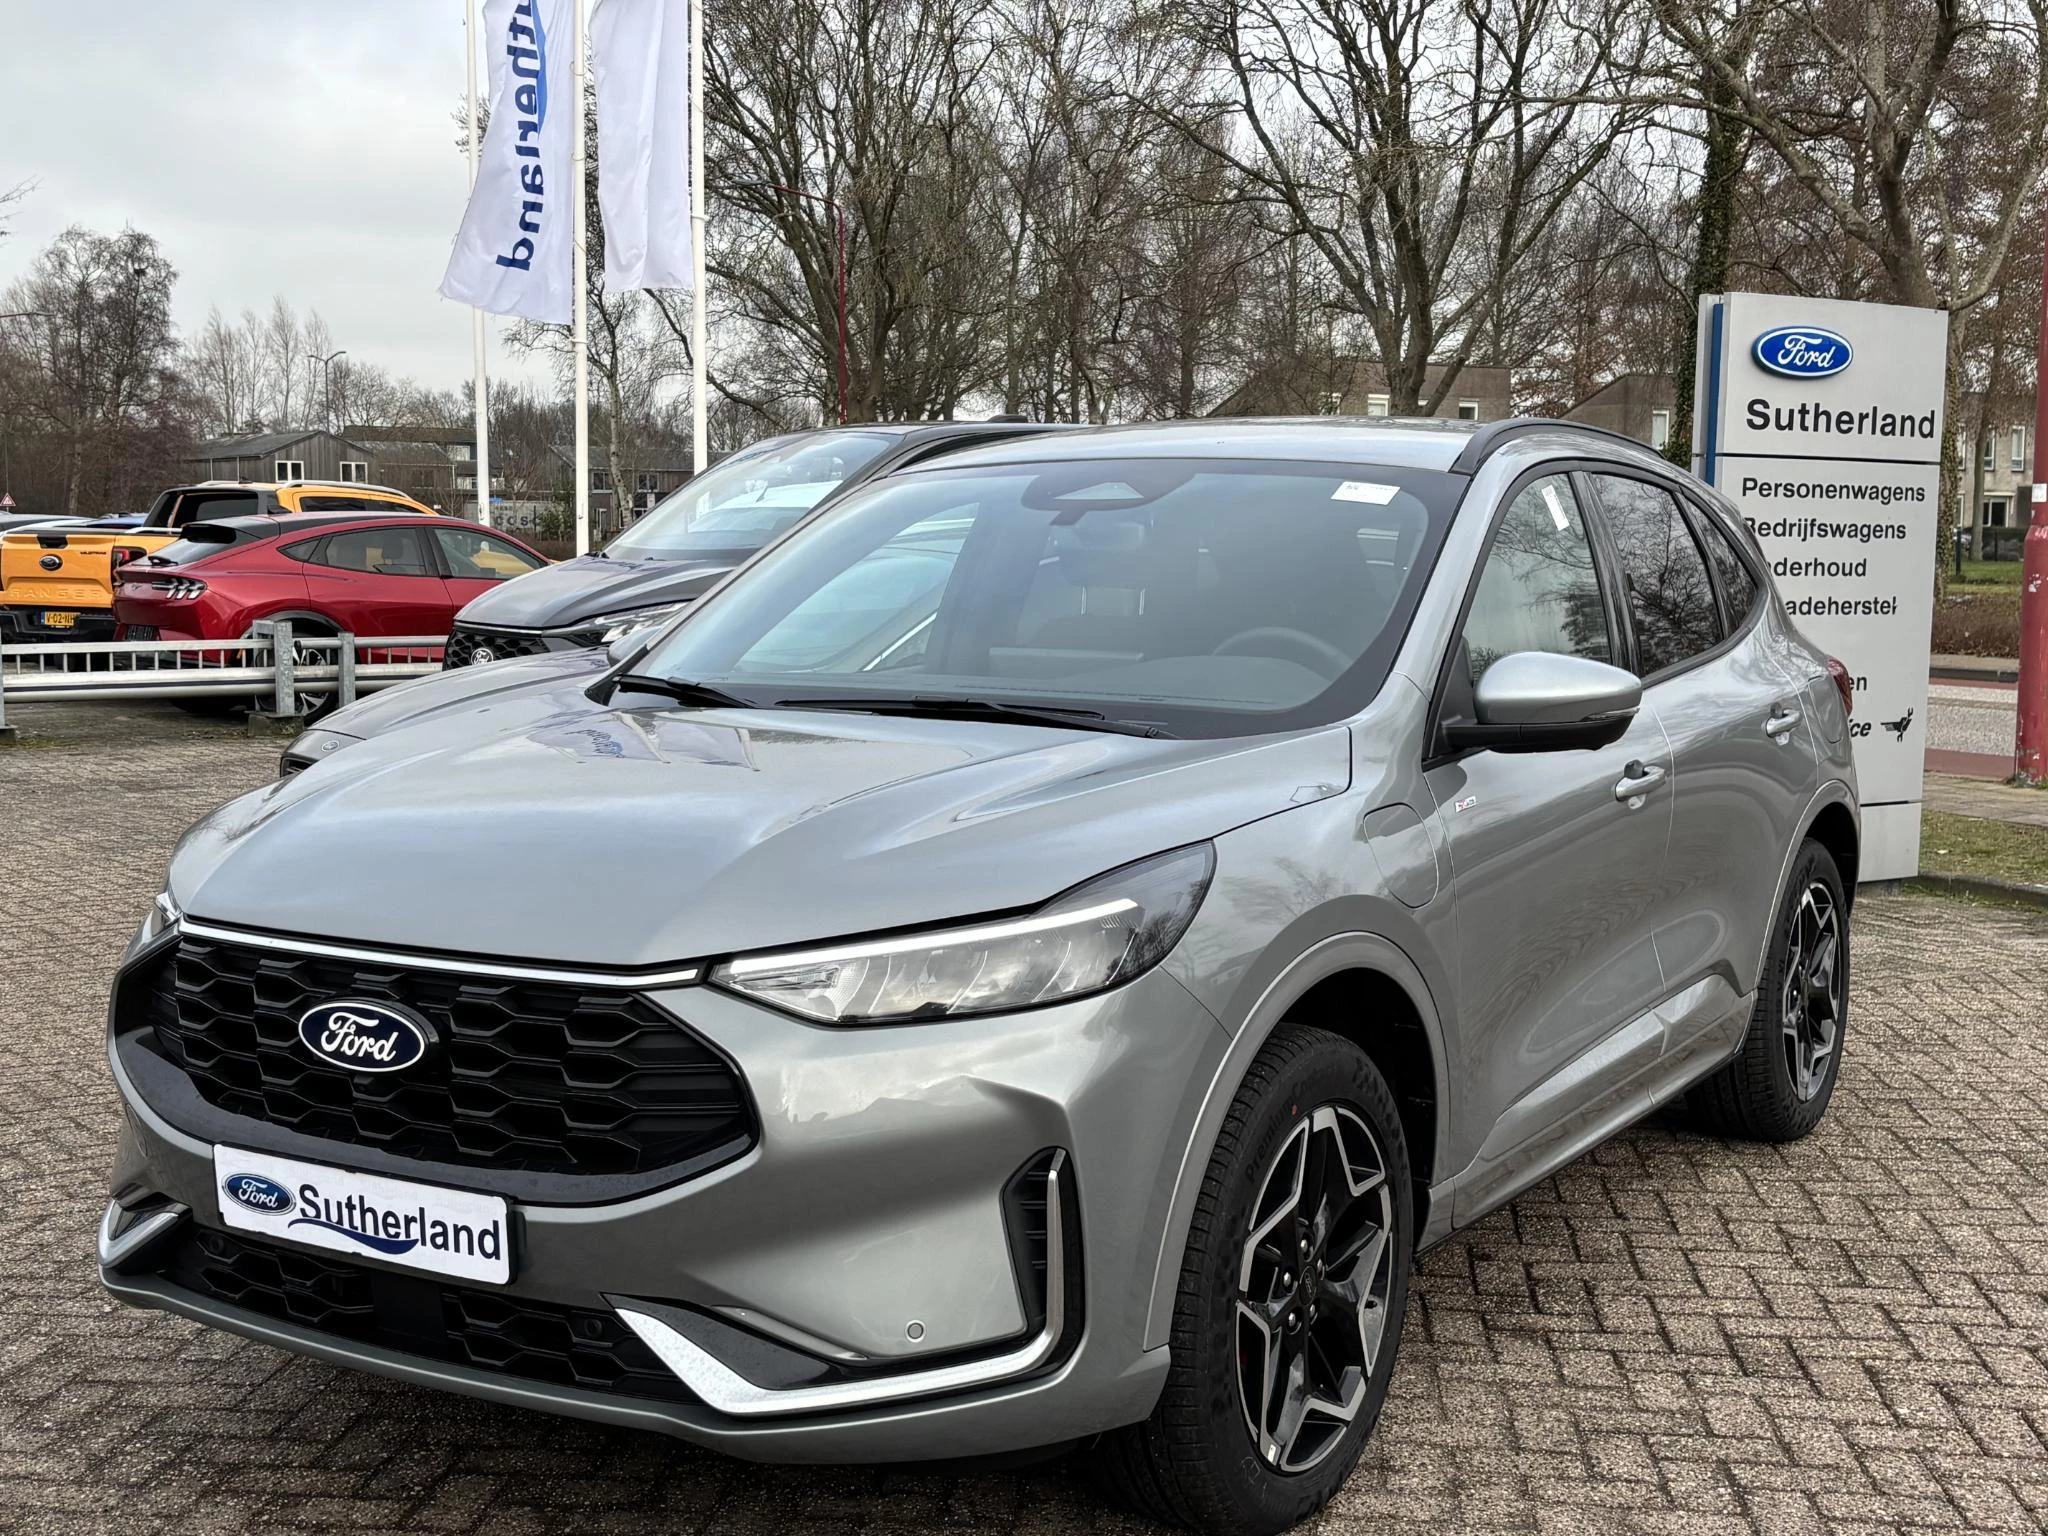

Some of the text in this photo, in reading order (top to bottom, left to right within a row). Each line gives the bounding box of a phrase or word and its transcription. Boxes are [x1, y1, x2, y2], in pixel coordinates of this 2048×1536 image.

[1777, 334, 1836, 368] Ford
[1746, 398, 1936, 439] Sutherland
[1742, 477, 1926, 506] Personenwagens
[1744, 517, 1907, 543] Bedrijfswagens
[1766, 557, 1867, 577] derhoud
[1785, 596, 1898, 616] adeherstel
[321, 1012, 399, 1062] Ford
[238, 1178, 501, 1260] Ford Sutherland
